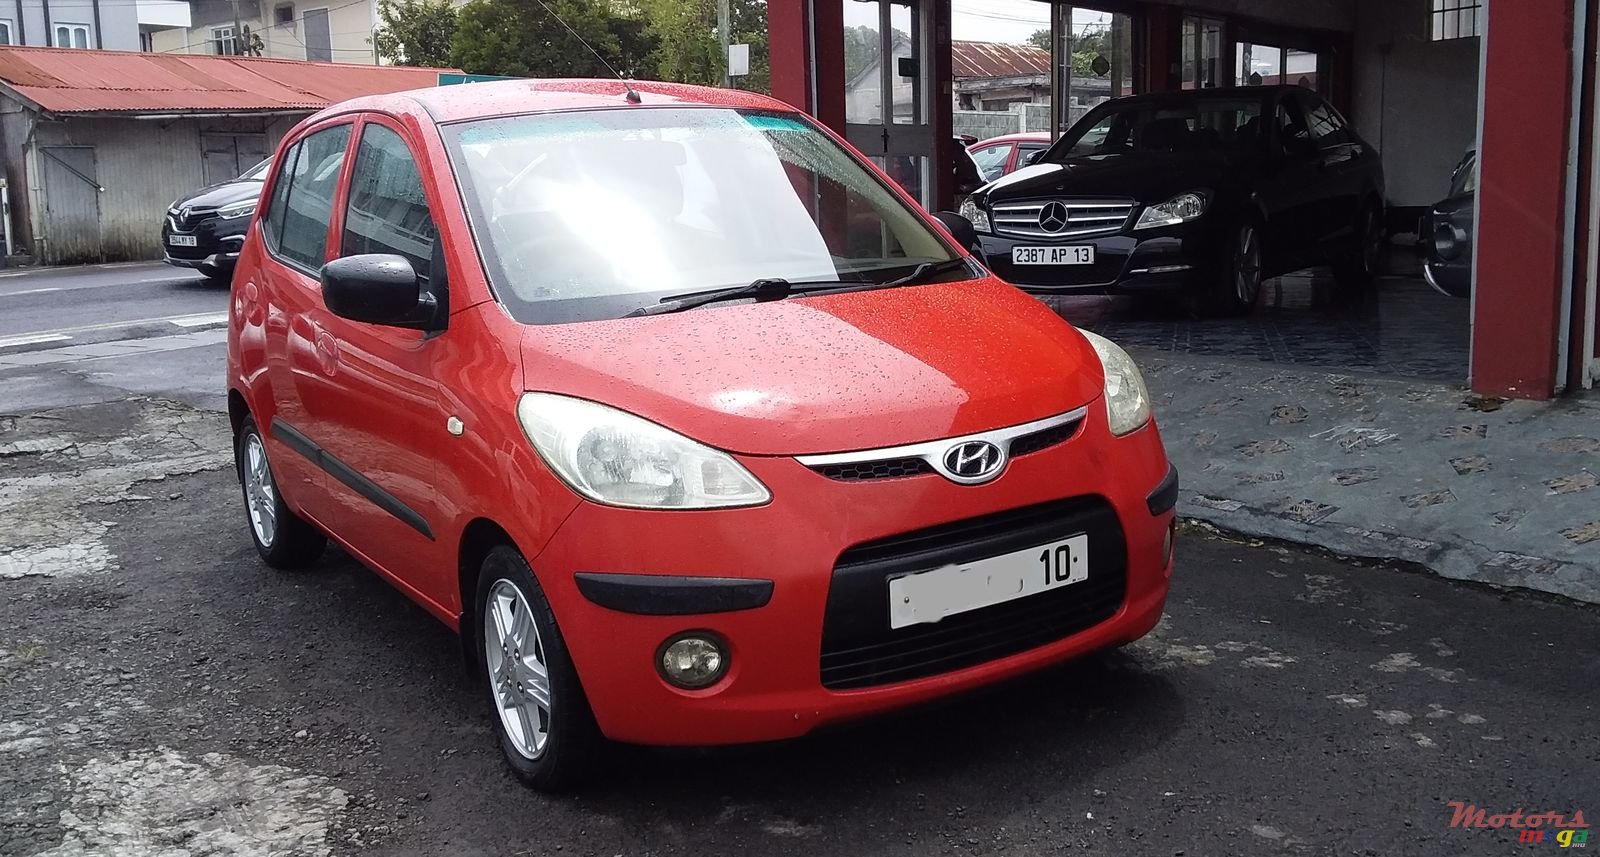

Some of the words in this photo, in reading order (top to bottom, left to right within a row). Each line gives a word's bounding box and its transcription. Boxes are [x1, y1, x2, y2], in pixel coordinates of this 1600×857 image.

[1016, 248, 1045, 263] 2387
[1051, 248, 1067, 263] AP
[1074, 248, 1089, 262] 13
[1039, 544, 1071, 586] 10
